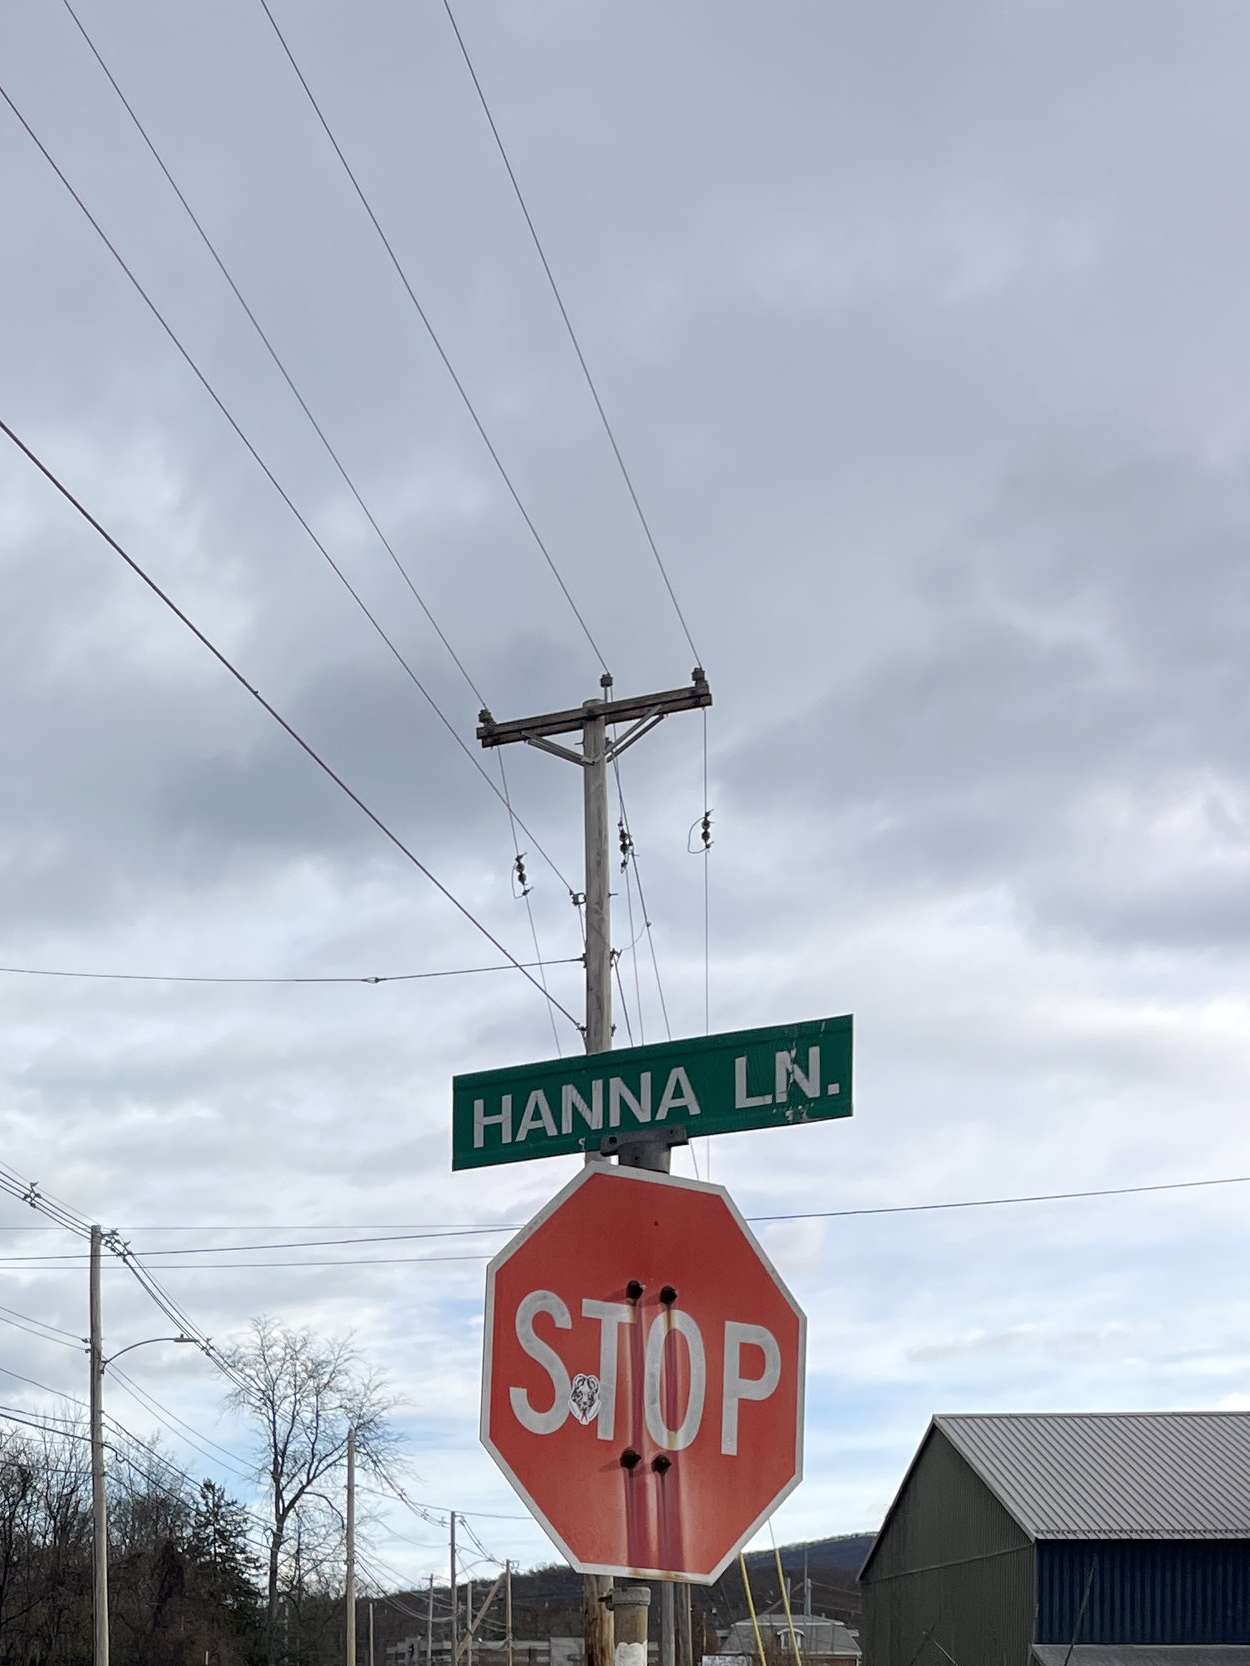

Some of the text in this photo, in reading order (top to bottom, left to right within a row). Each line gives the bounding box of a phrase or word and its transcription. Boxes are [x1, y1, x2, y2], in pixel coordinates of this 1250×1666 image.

[473, 1046, 840, 1149] HANNA LN.
[509, 1289, 782, 1457] STOP
